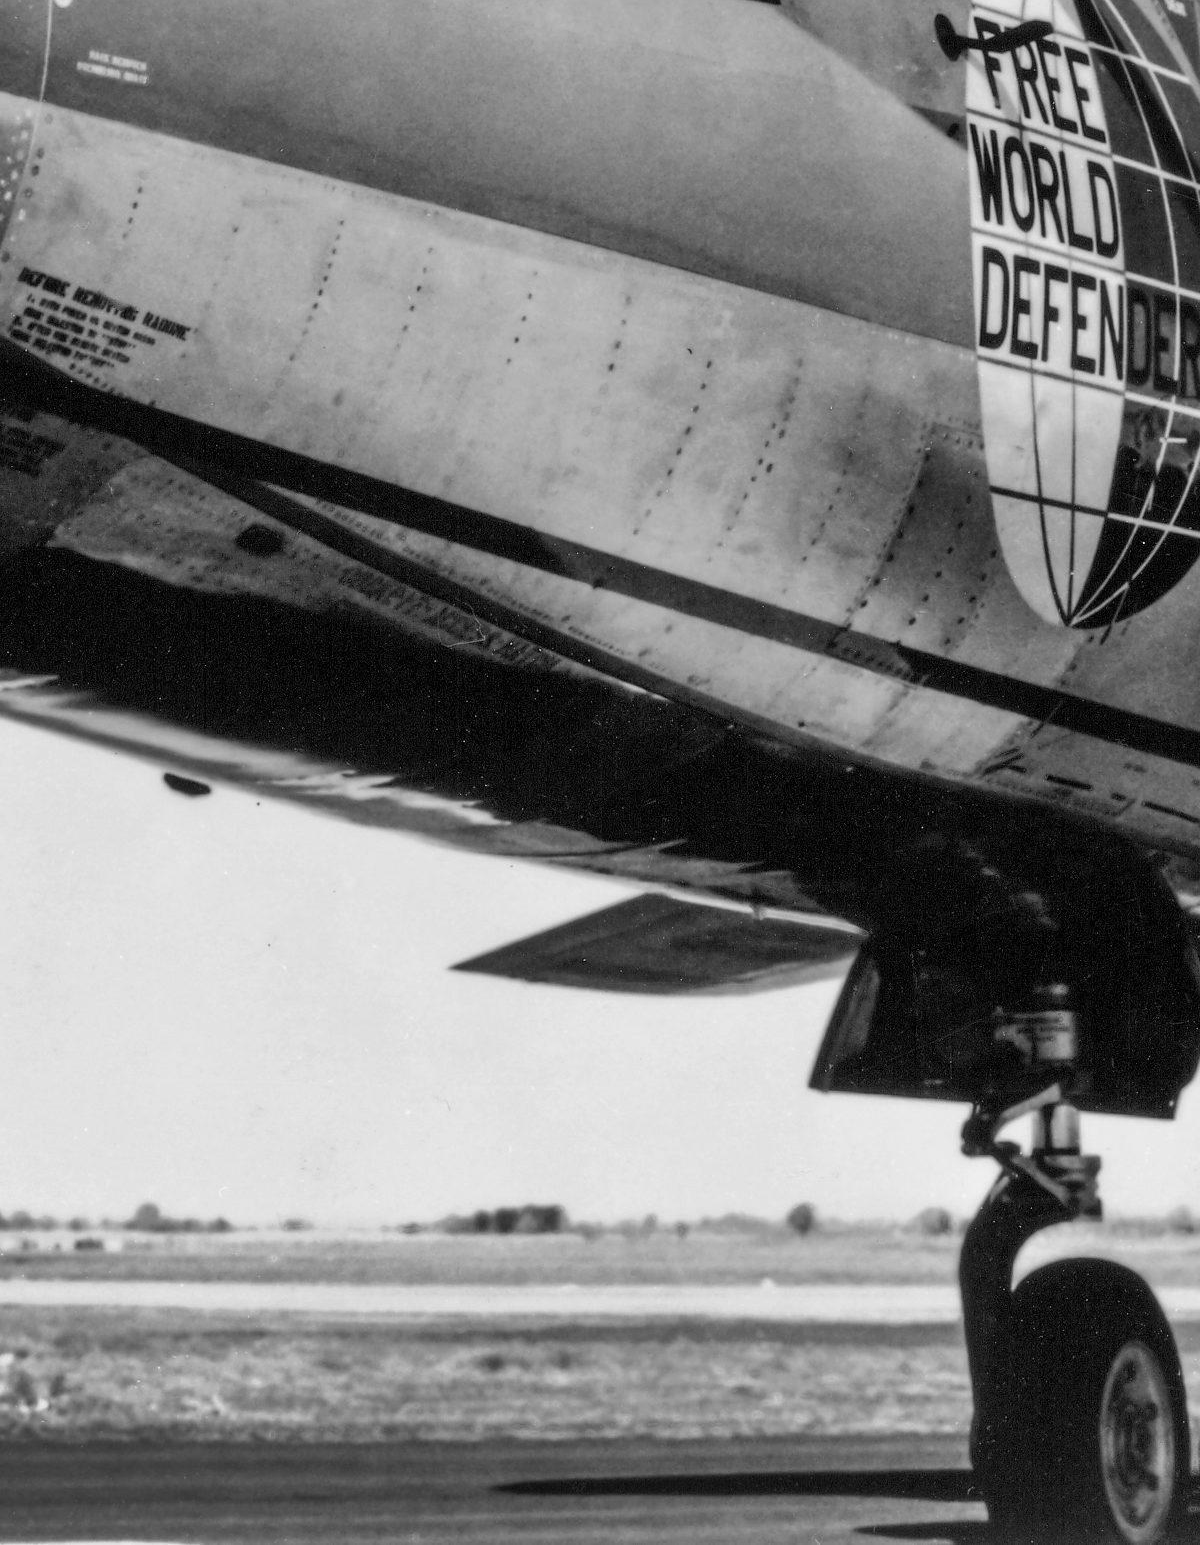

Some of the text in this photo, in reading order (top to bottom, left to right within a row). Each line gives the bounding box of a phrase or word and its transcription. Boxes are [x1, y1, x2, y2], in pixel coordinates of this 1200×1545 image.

[974, 16, 1106, 144] FREE
[969, 122, 1119, 259] WORLD
[979, 244, 1200, 398] DEFENDER
